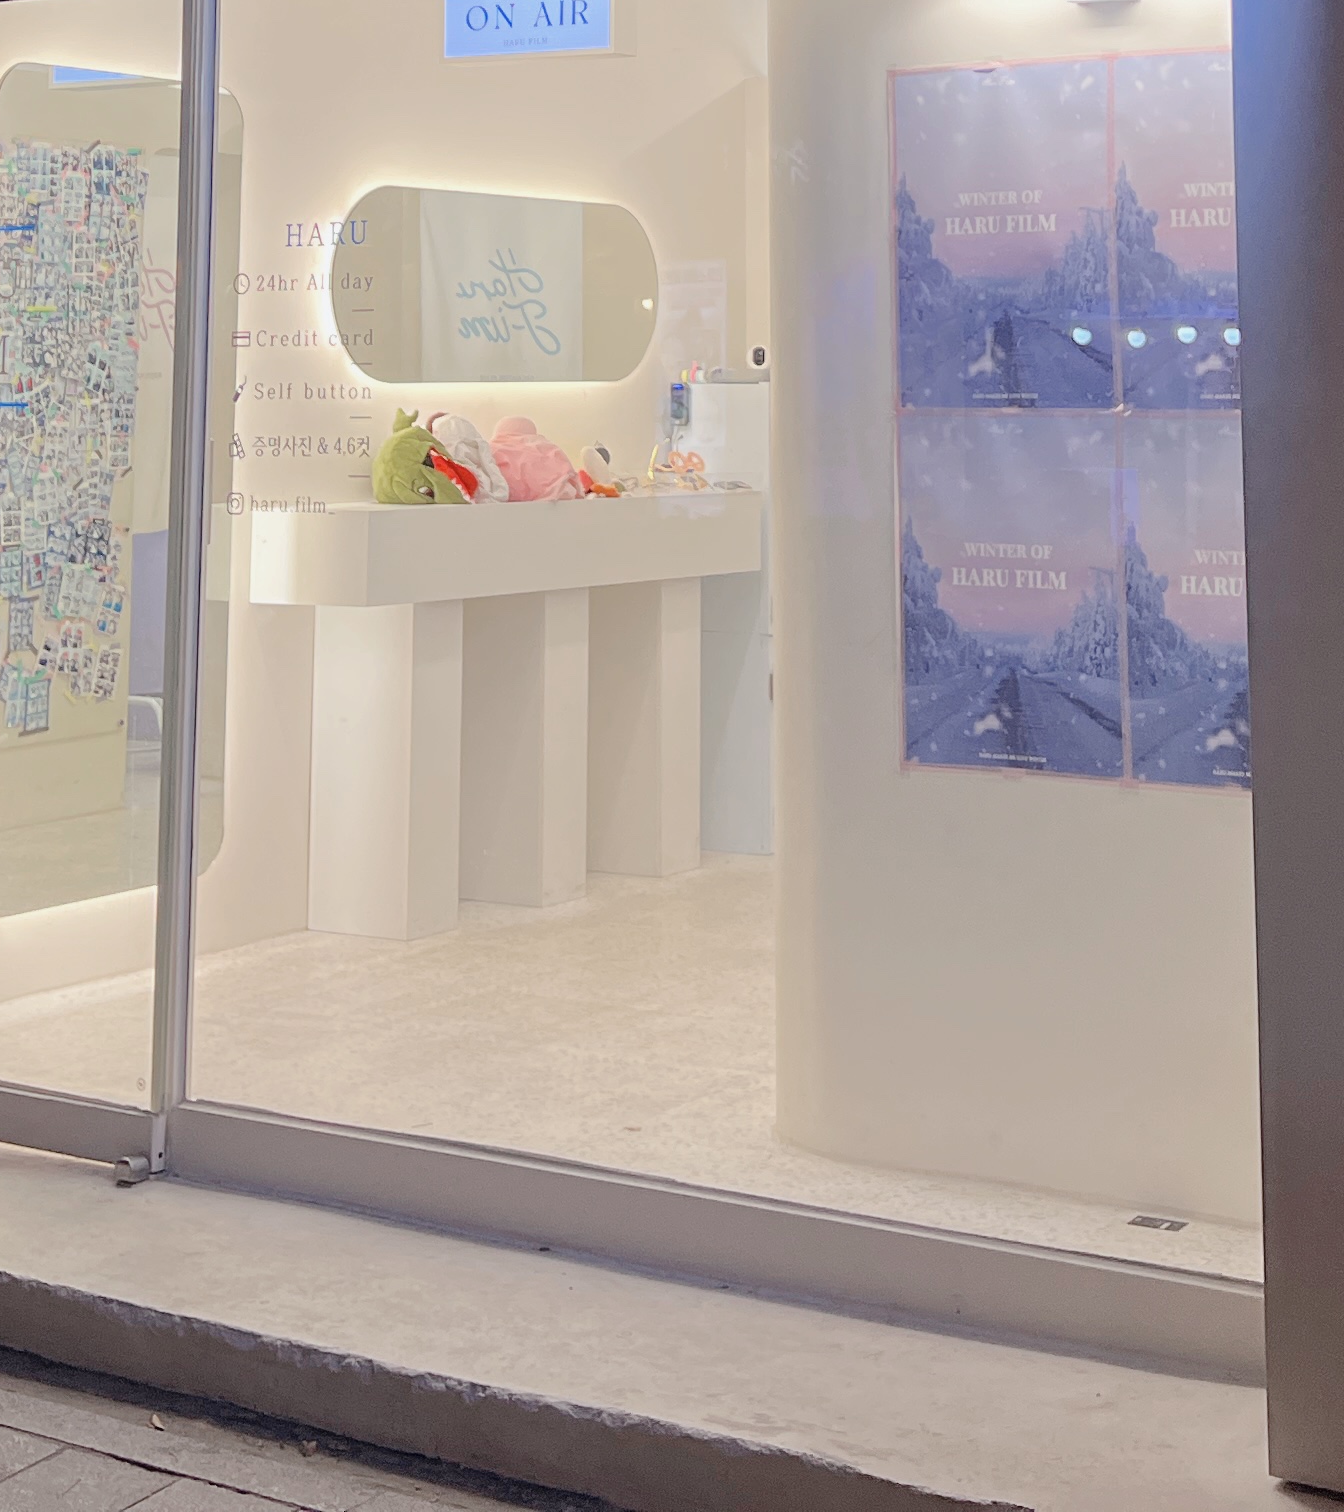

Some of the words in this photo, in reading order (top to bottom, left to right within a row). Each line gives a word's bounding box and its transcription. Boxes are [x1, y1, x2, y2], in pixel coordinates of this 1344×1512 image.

[465, 3, 515, 31] ON
[958, 191, 1018, 208] WINTER
[1022, 189, 1043, 205] OF
[945, 215, 1001, 236] HARU
[1005, 213, 1057, 233] FILM
[1169, 207, 1232, 228] HARU
[285, 219, 368, 247] HARU
[256, 274, 299, 293] 24hr
[306, 273, 333, 291] All
[341, 272, 373, 293] day
[256, 329, 318, 347] Credit
[328, 328, 373, 347] card
[254, 382, 293, 400] Self
[304, 382, 372, 400] button
[252, 435, 312, 458] 증명사진
[317, 436, 330, 455] &
[964, 542, 1028, 559] WINTER
[1030, 543, 1053, 560] OF
[951, 566, 1010, 588] HARU
[1015, 569, 1068, 591] FILM
[1180, 575, 1244, 597] HARU
